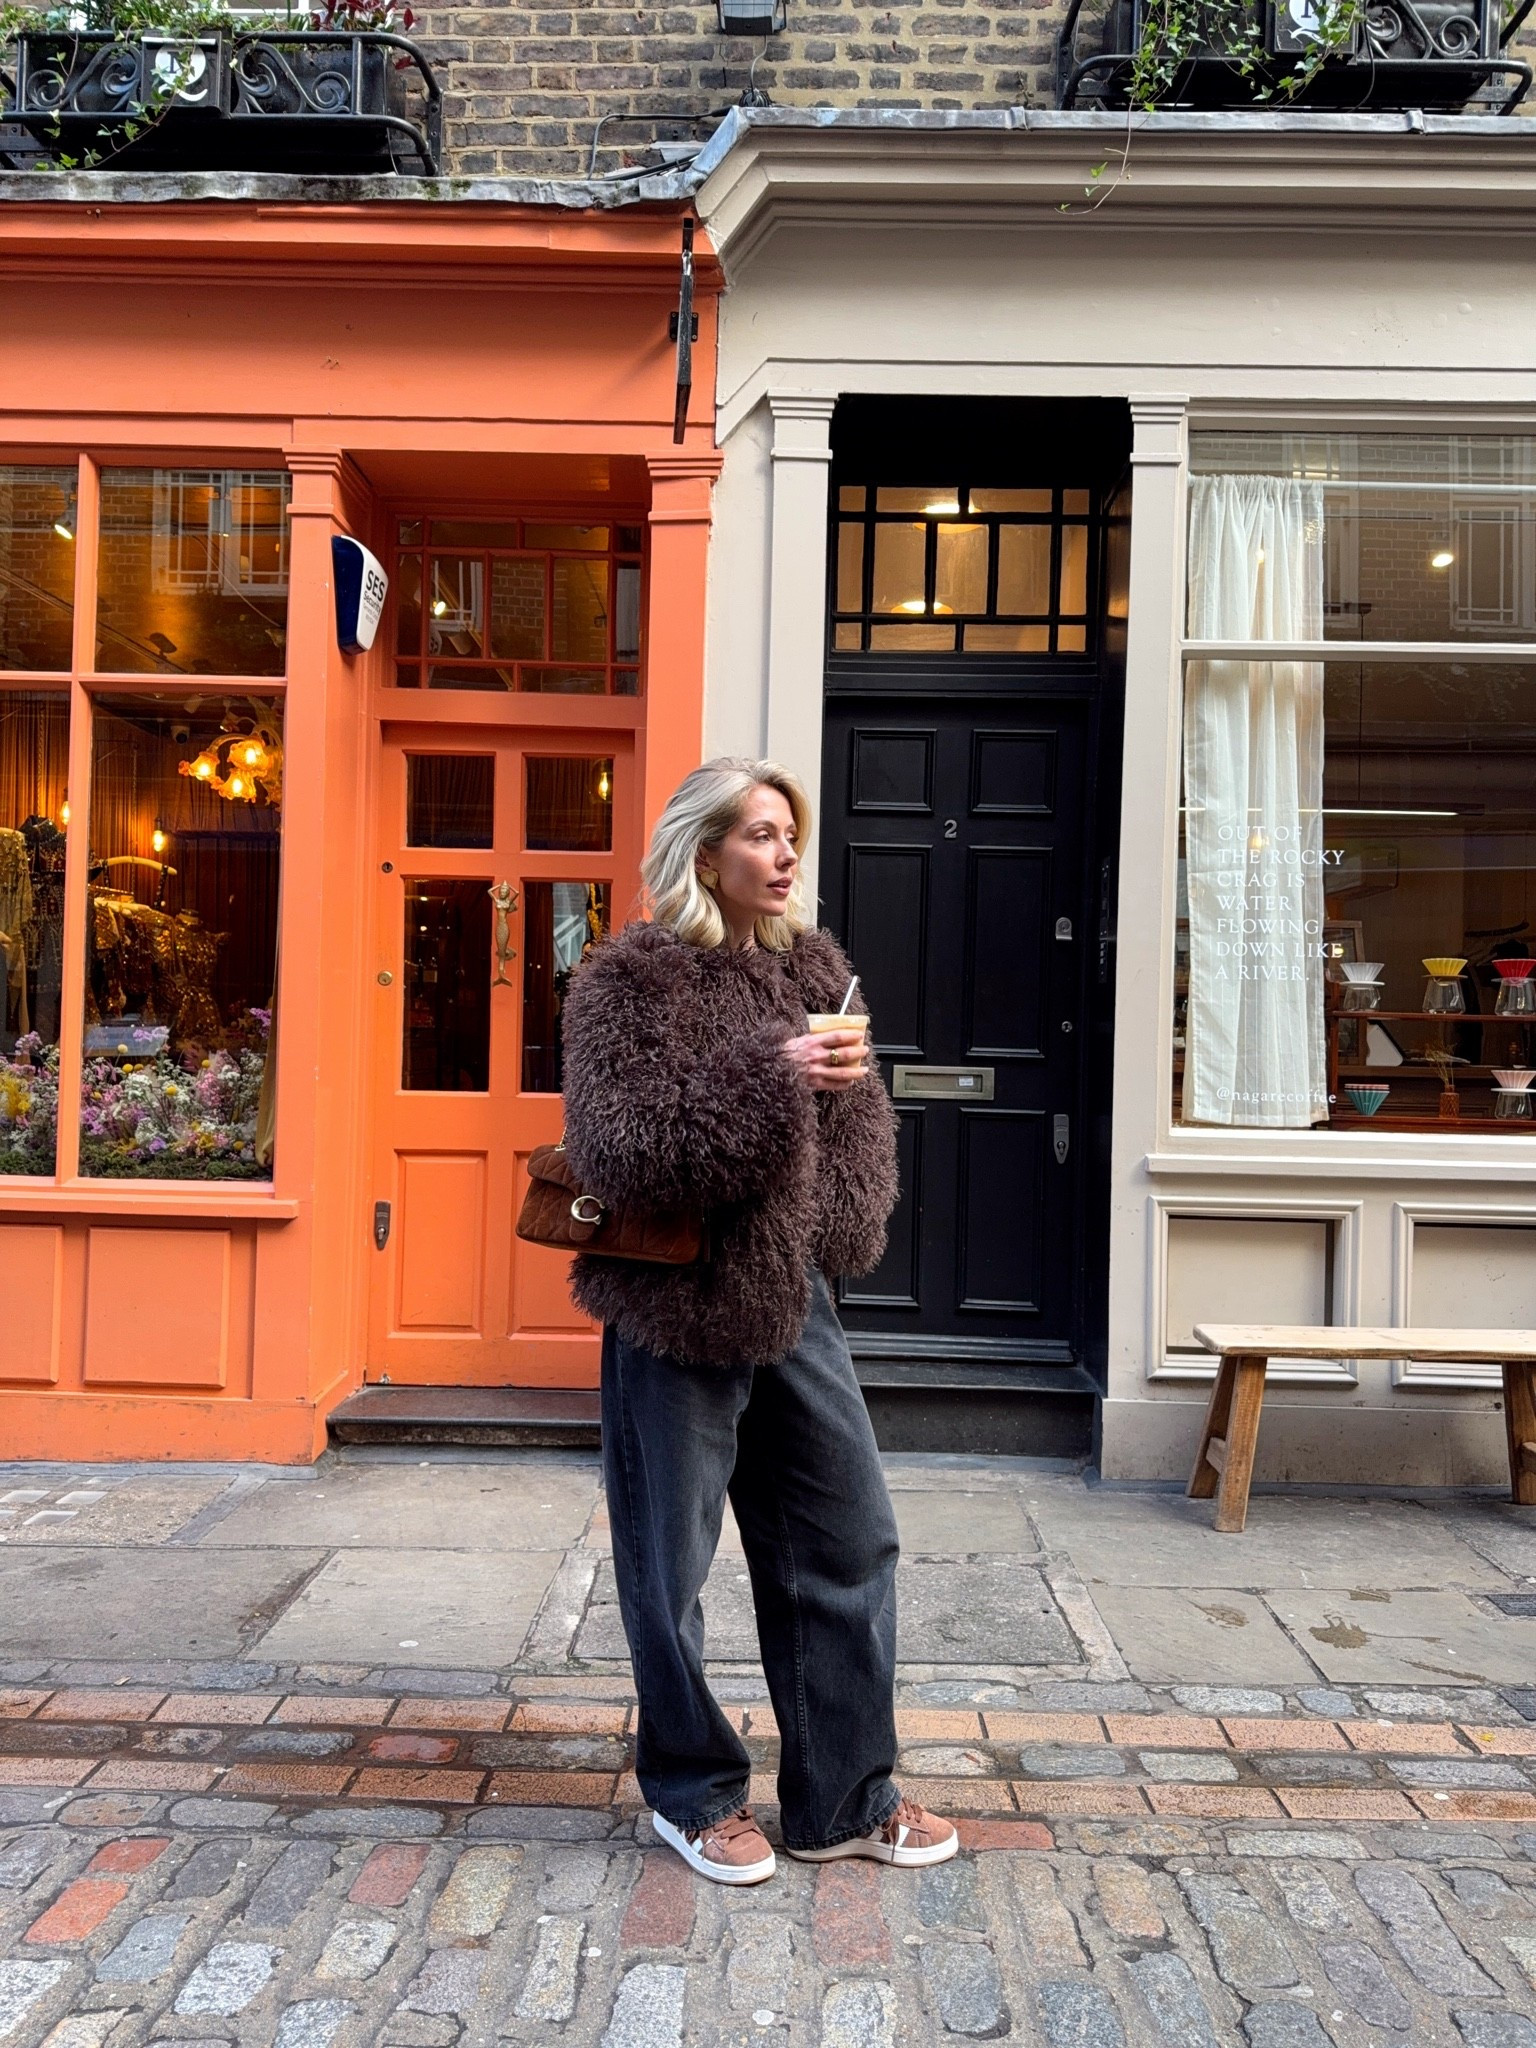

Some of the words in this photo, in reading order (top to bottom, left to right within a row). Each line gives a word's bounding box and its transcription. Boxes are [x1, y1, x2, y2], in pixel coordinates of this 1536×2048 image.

[366, 569, 385, 602] SES
[944, 819, 957, 838] 2
[1217, 825, 1266, 841] OUT
[1274, 826, 1303, 841] OF
[1217, 848, 1261, 864] THE
[1270, 849, 1345, 865] ROCKY
[1217, 872, 1278, 888] CRAG
[1287, 872, 1305, 888] IS
[1216, 895, 1292, 911] WATER
[1216, 918, 1319, 935] FLOWING
[1216, 941, 1285, 957] DOWN
[1295, 942, 1343, 958] LIKE
[1215, 964, 1229, 980] A
[1240, 965, 1310, 981] RIVER.
[1216, 1086, 1337, 1104] @nagarecoffee
[571, 1195, 605, 1225] C
